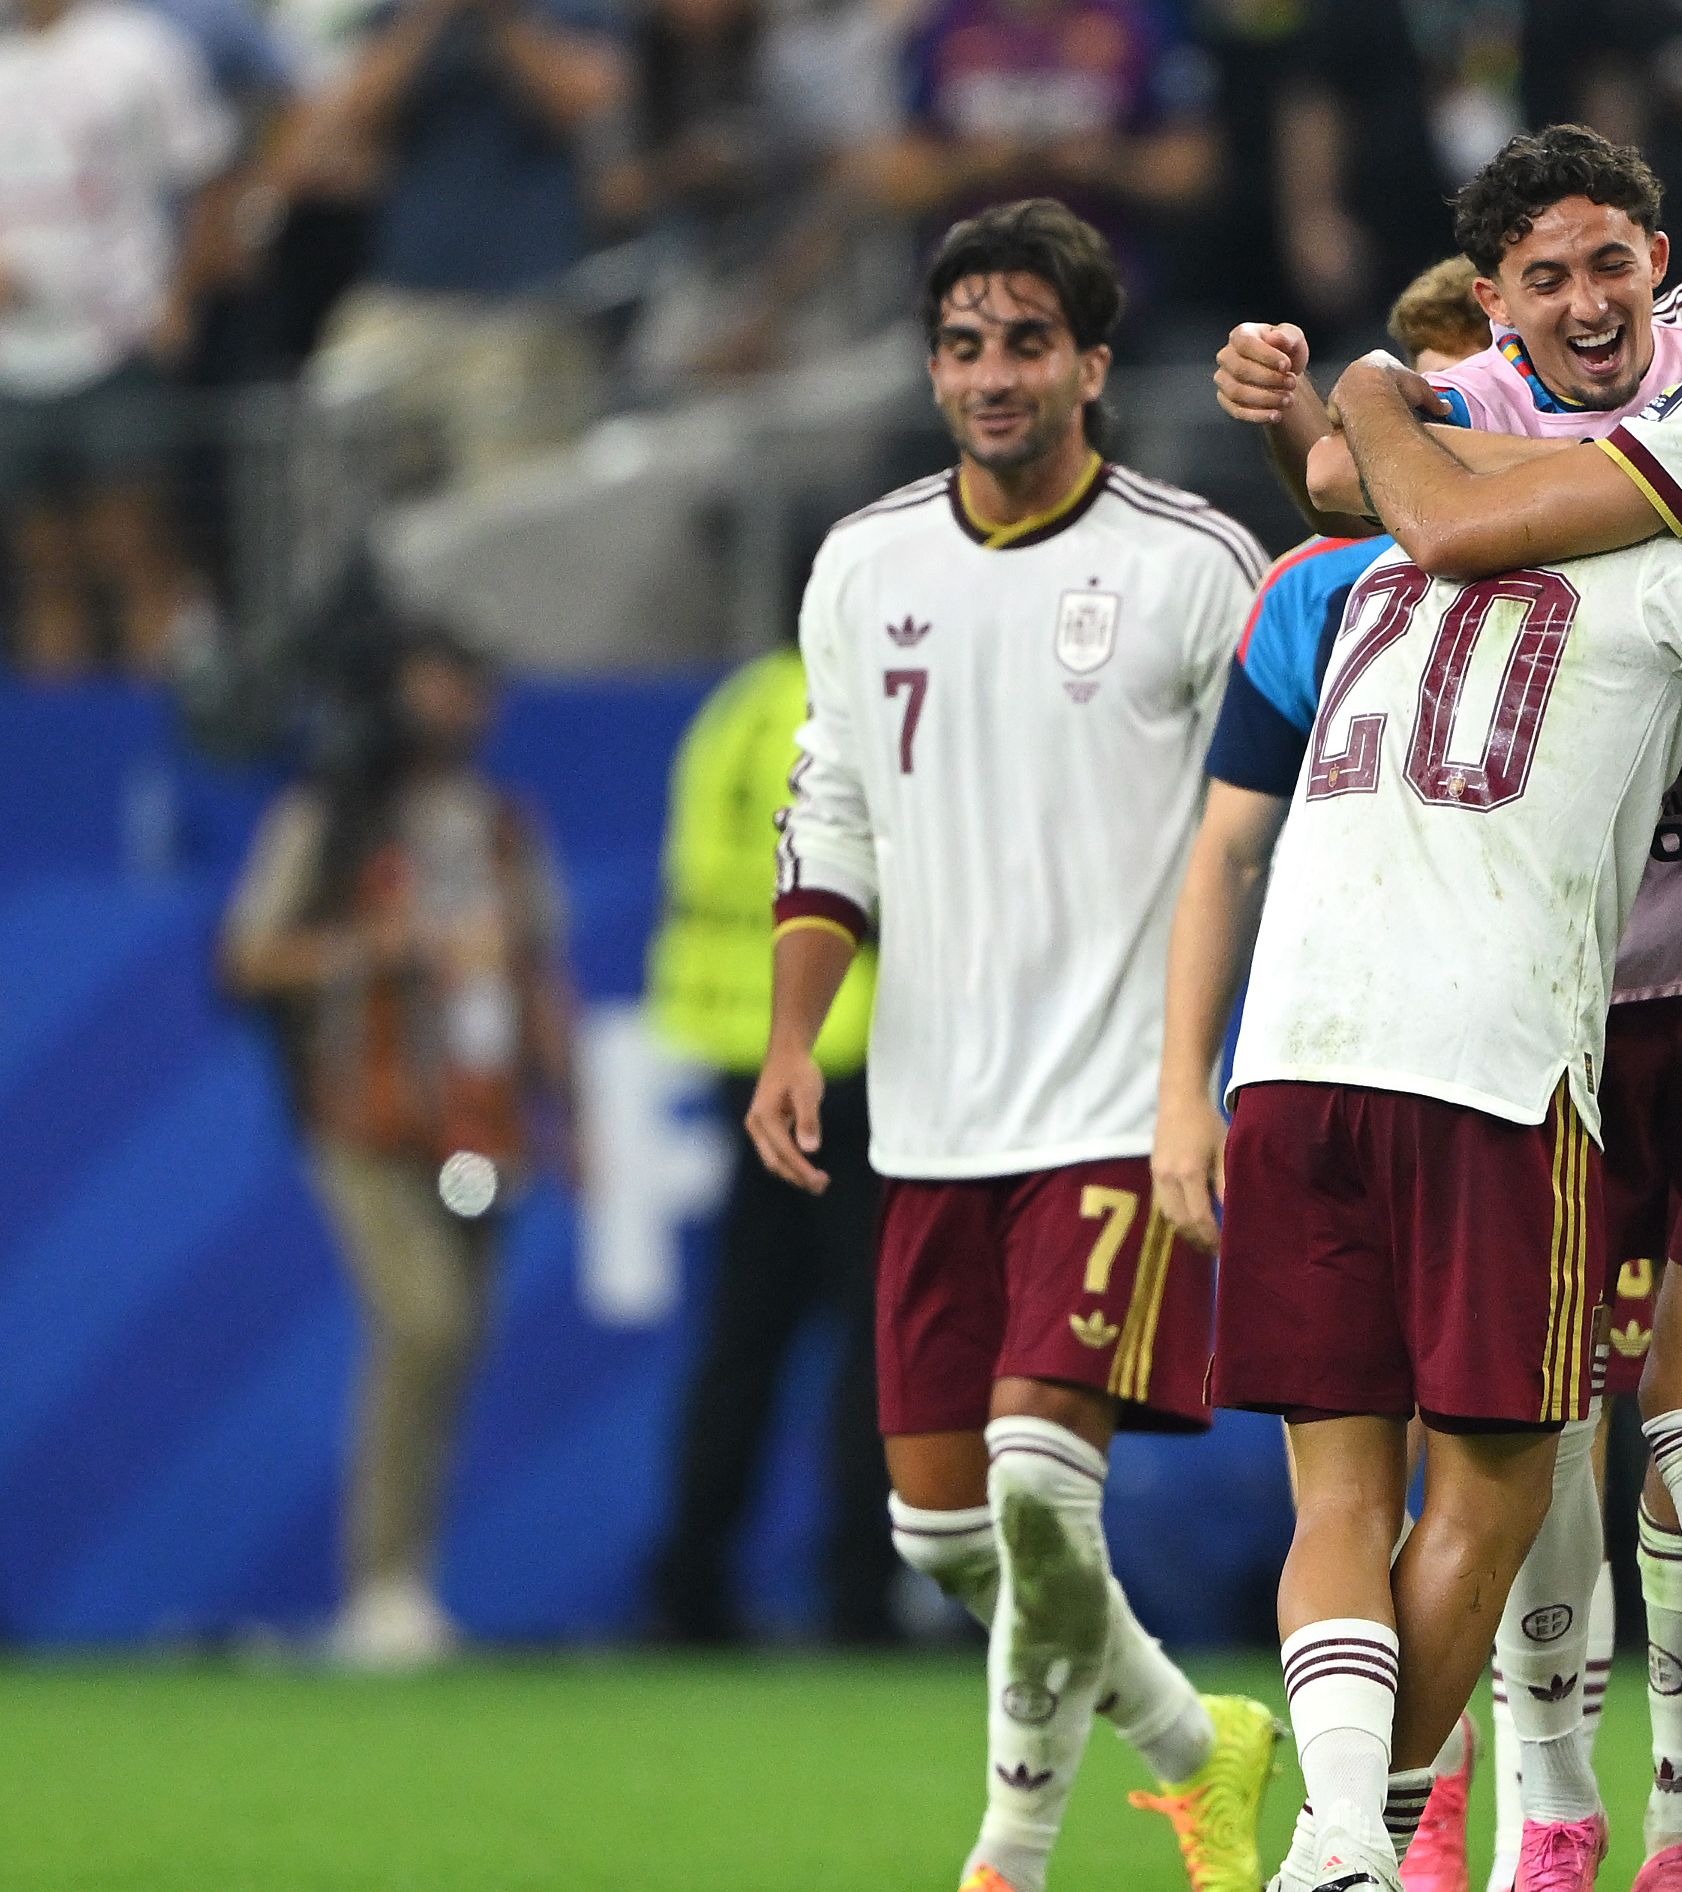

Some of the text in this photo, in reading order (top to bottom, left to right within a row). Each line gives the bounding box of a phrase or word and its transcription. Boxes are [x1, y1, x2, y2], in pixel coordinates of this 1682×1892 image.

[884, 669, 930, 775] 7
[1306, 560, 1581, 814] 20
[1080, 1184, 1138, 1295] 7
